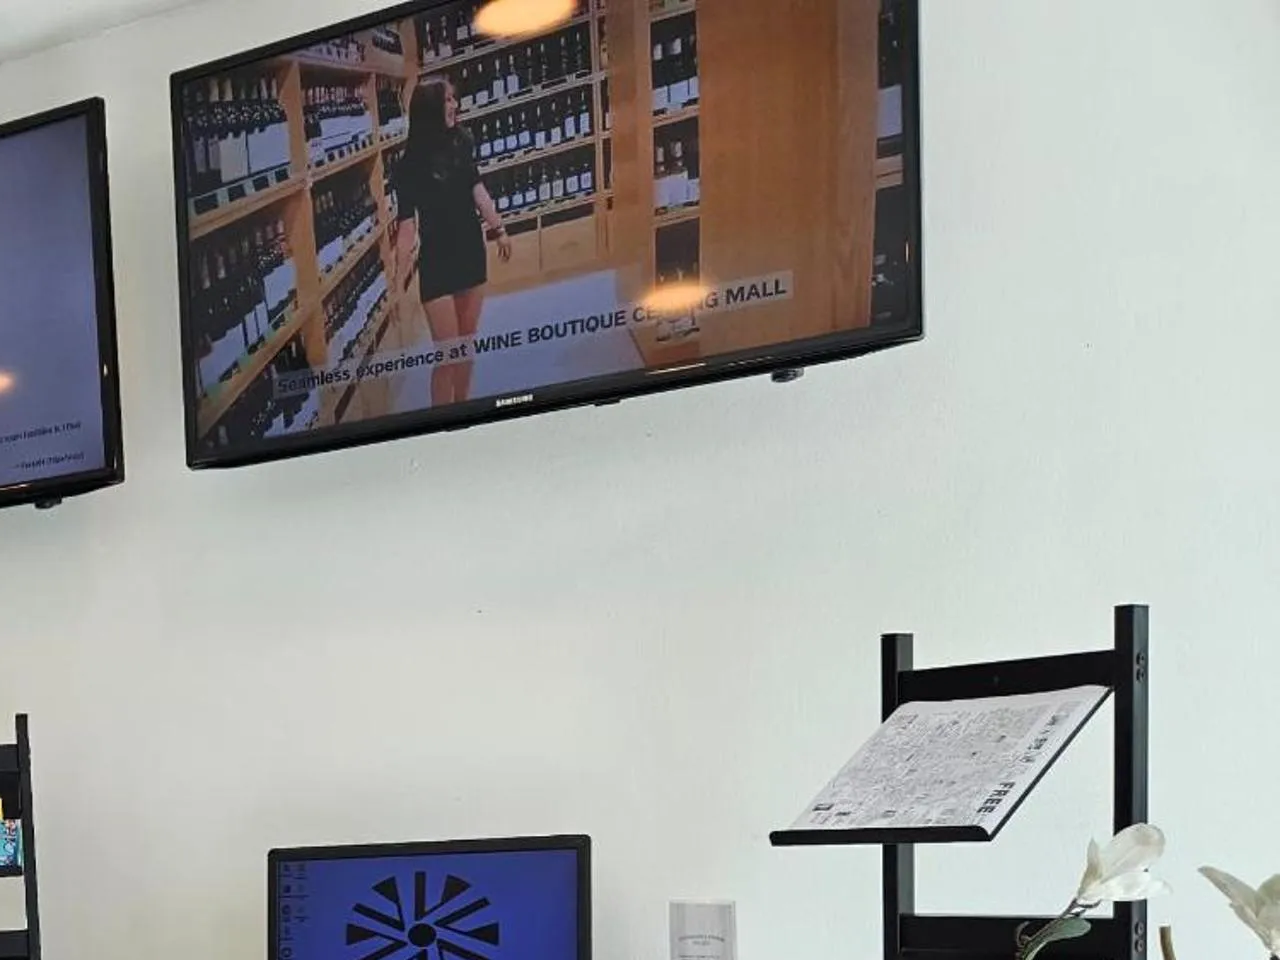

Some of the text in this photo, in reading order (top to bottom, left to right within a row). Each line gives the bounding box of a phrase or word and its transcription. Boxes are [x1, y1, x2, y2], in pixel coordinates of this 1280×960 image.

[277, 278, 787, 394] Seamless experience at WINE BOUTIQUE CEG MALL
[976, 781, 1017, 814] FREE
